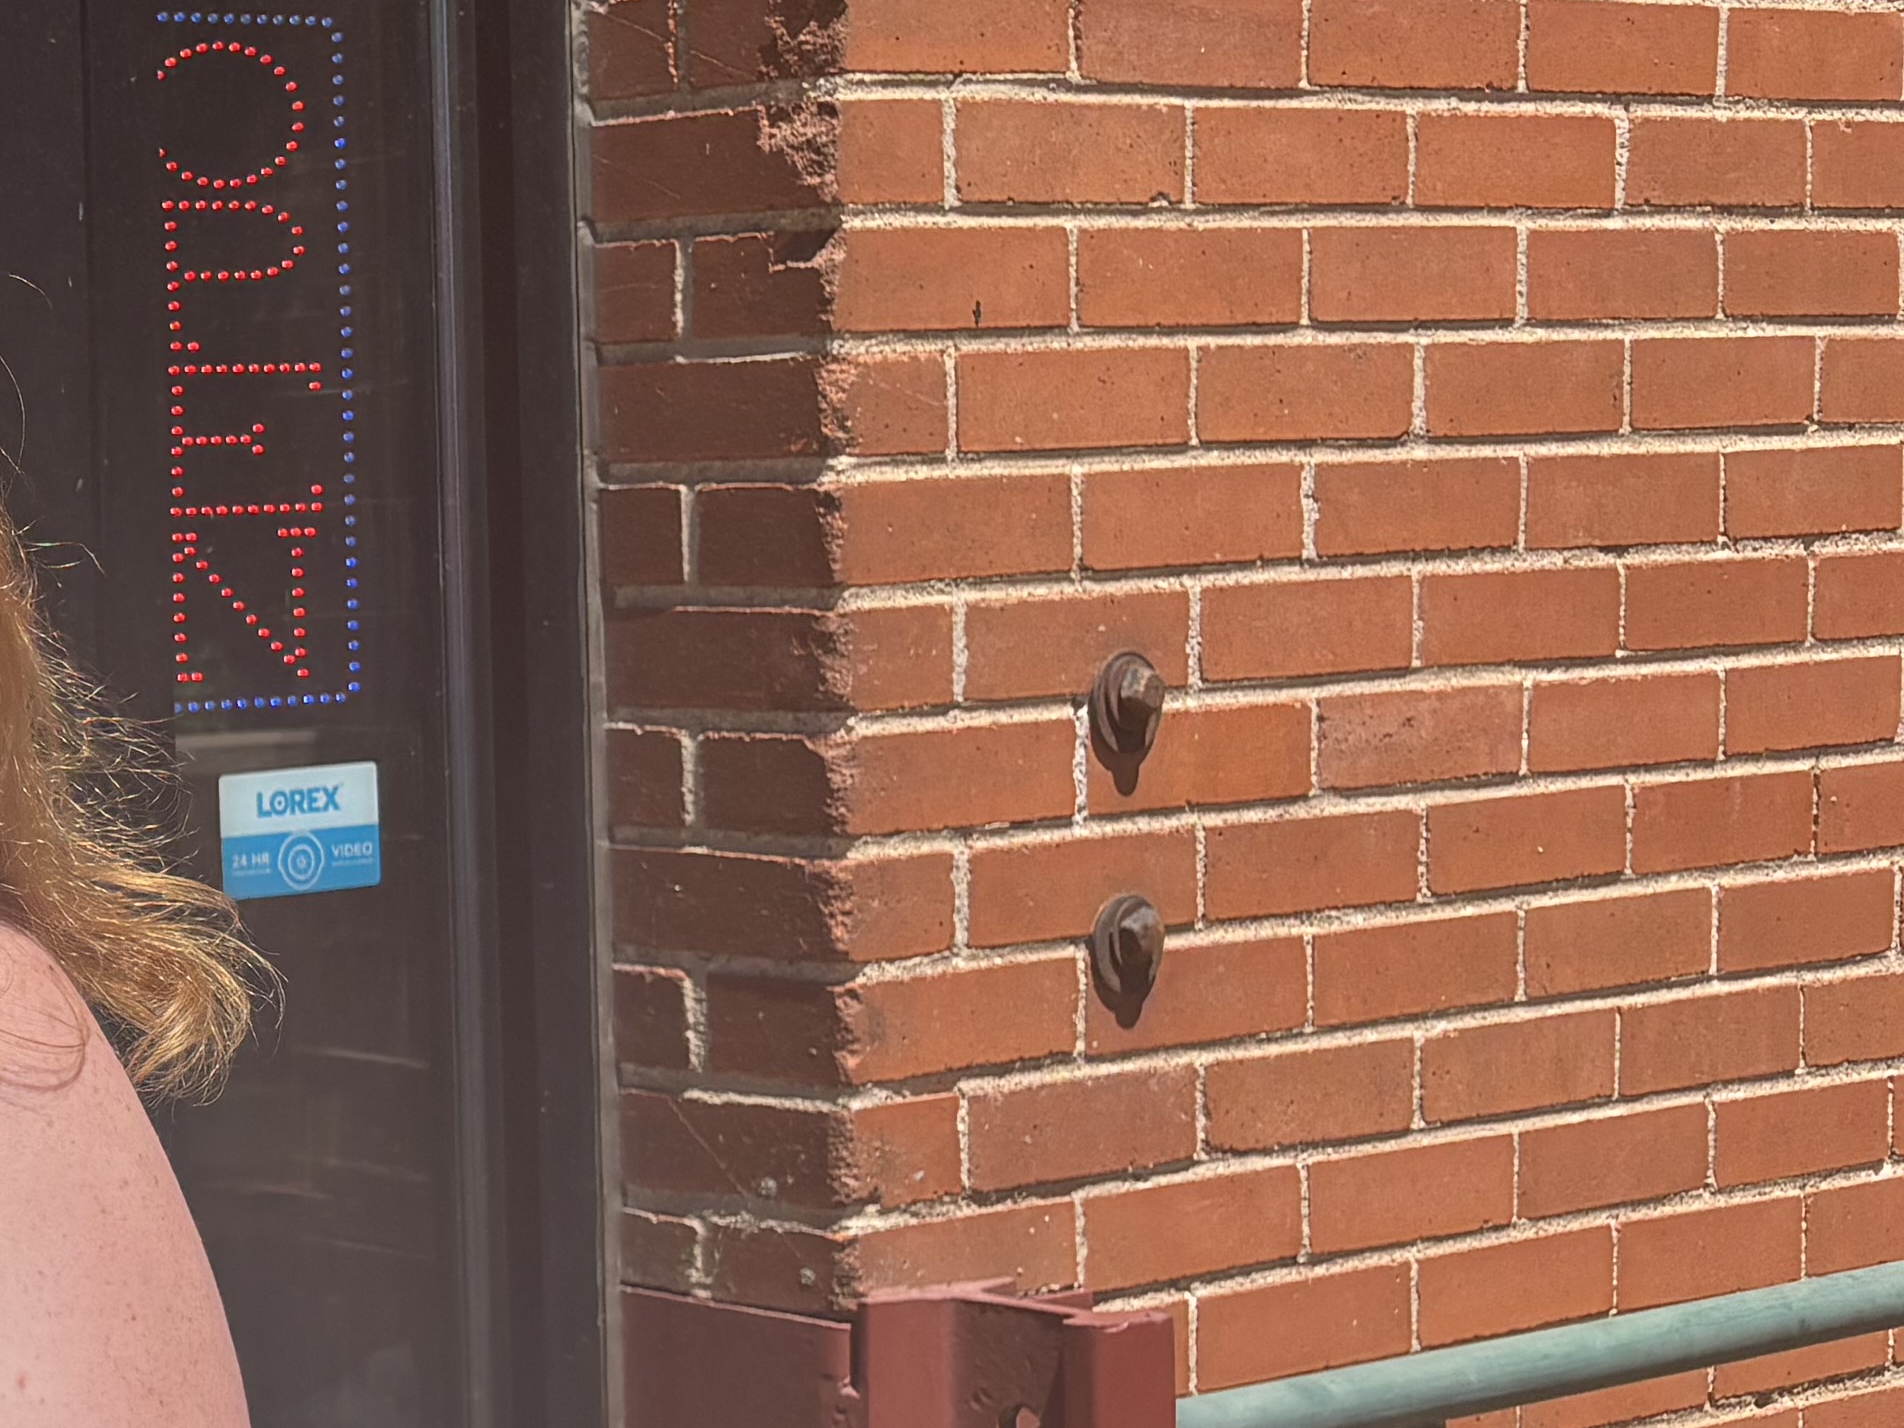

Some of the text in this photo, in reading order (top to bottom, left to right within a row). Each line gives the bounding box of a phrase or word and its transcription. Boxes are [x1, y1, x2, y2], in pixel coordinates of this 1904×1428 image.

[156, 38, 323, 684] OPEN
[256, 785, 341, 818] LOREX
[232, 852, 270, 869] 24 HR
[331, 841, 373, 858] VIDEO
